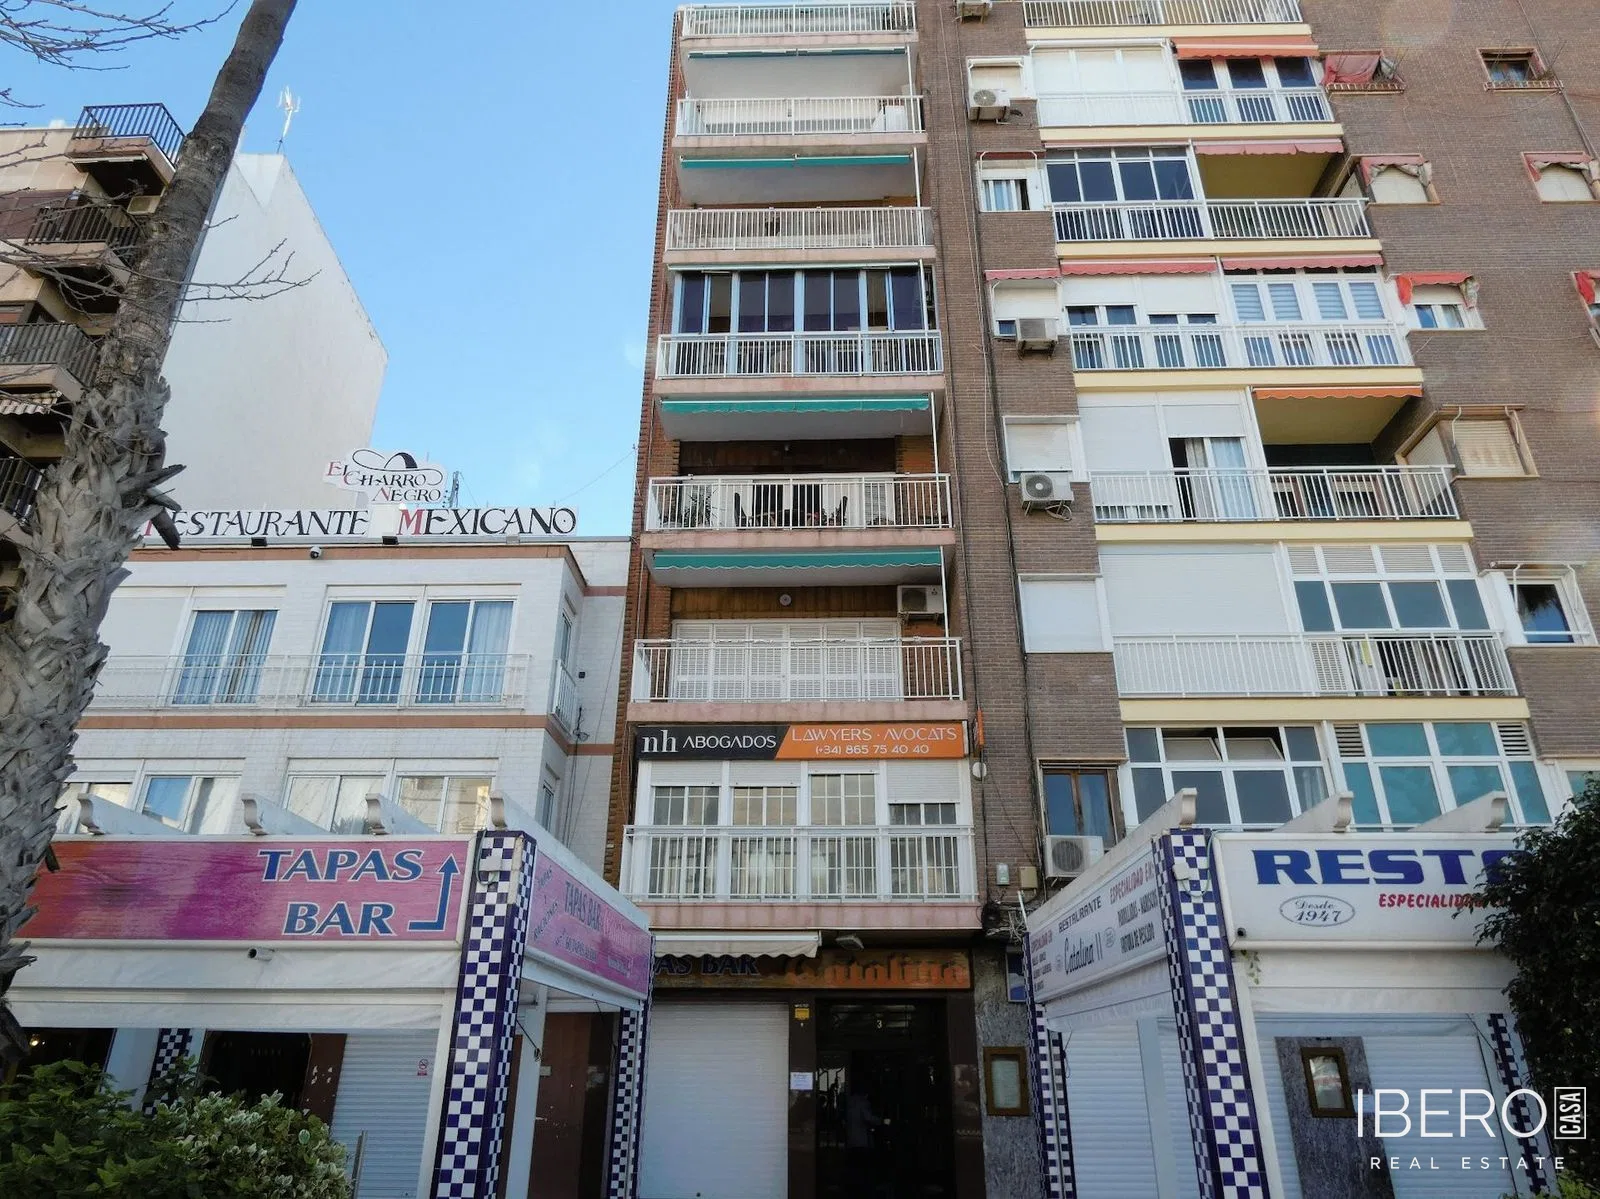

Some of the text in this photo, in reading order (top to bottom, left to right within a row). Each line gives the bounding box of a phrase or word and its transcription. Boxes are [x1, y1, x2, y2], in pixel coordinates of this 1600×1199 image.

[372, 487, 441, 503] NEGRO
[143, 508, 577, 537] ESTAURANTE MEXICANO
[642, 730, 777, 753] nh ABOGADOS
[792, 727, 957, 742] LAWYERS AVOCATS
[815, 744, 930, 755] (+34) 865 75 40 40
[258, 848, 424, 882] TAPAS
[565, 881, 587, 922] TAPAS
[281, 901, 397, 937] BAR
[1058, 896, 1102, 934] RESTAURANTE
[1295, 910, 1342, 923] 1947
[1064, 937, 1094, 976] Catalina
[876, 1019, 883, 1029] 3
